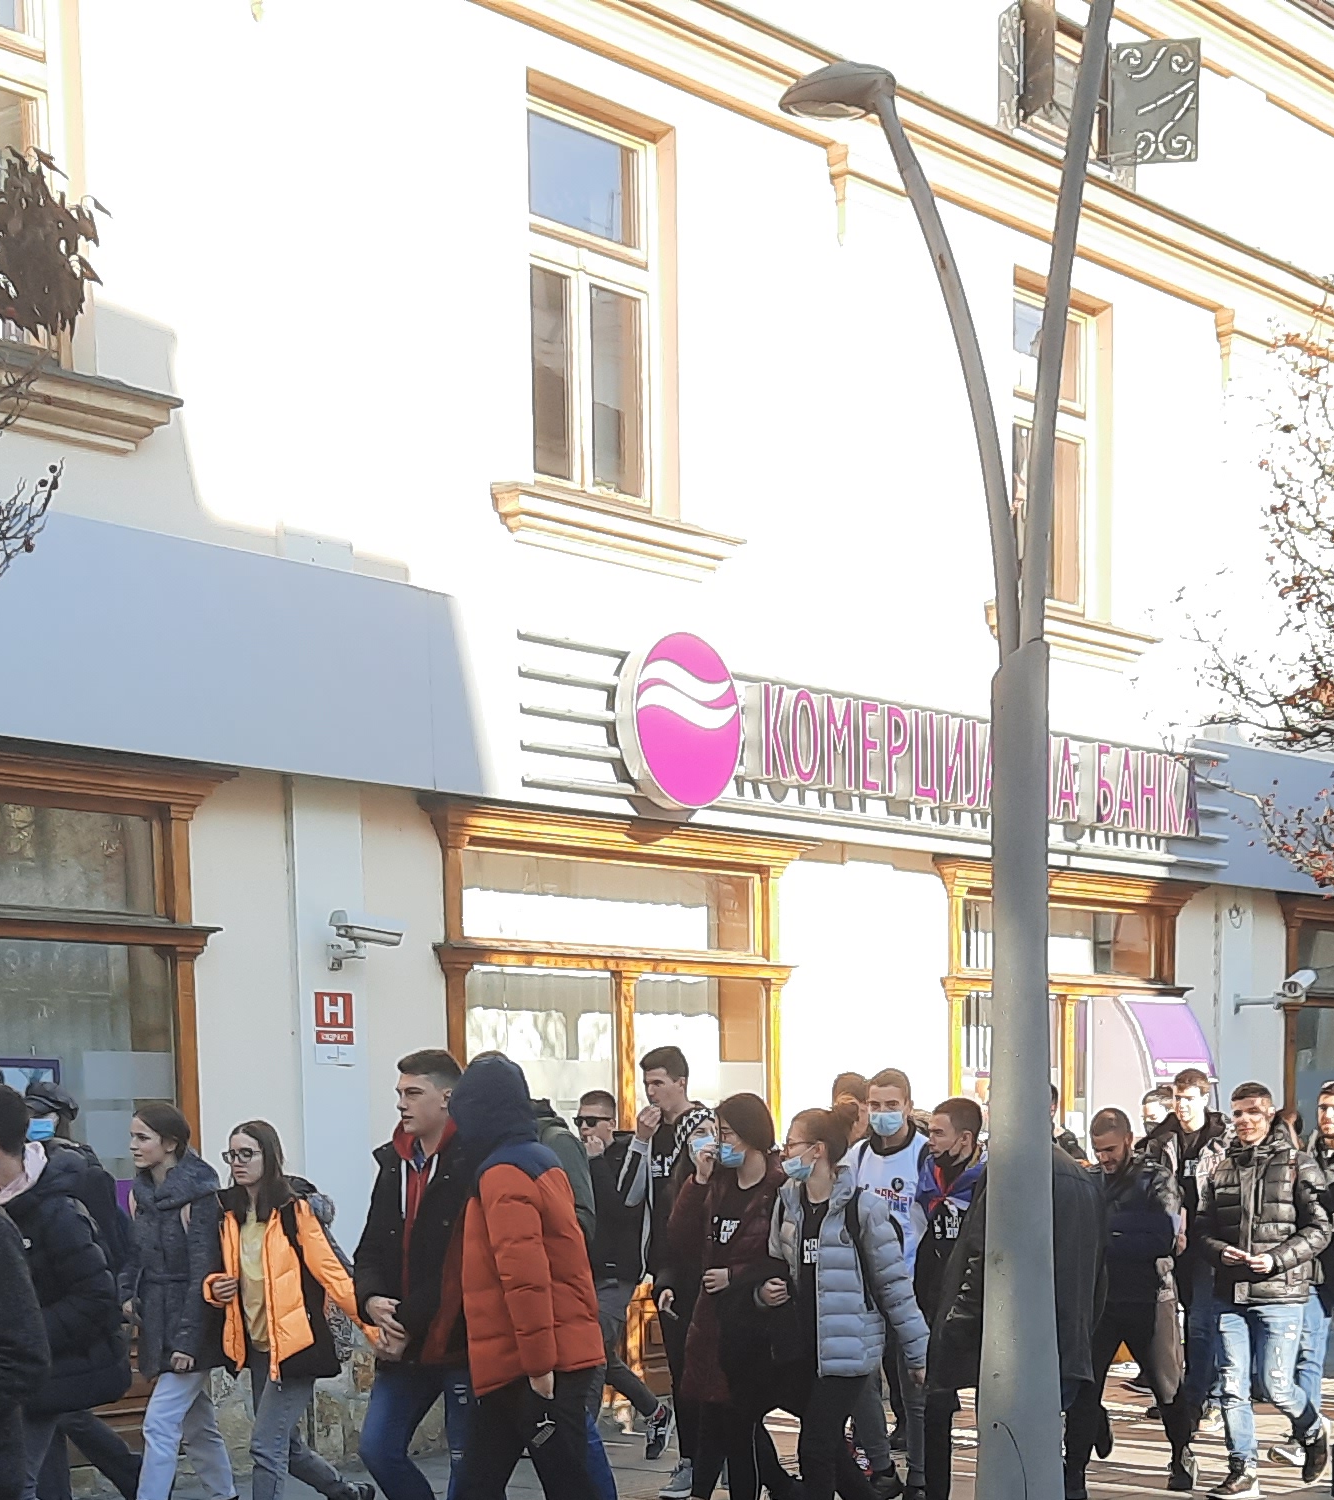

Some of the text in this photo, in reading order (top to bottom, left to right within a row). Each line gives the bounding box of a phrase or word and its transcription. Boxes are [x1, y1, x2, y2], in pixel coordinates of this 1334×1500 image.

[761, 683, 1200, 838] КОМЕРЦИЈА БАНКА
[323, 995, 344, 1024] H
